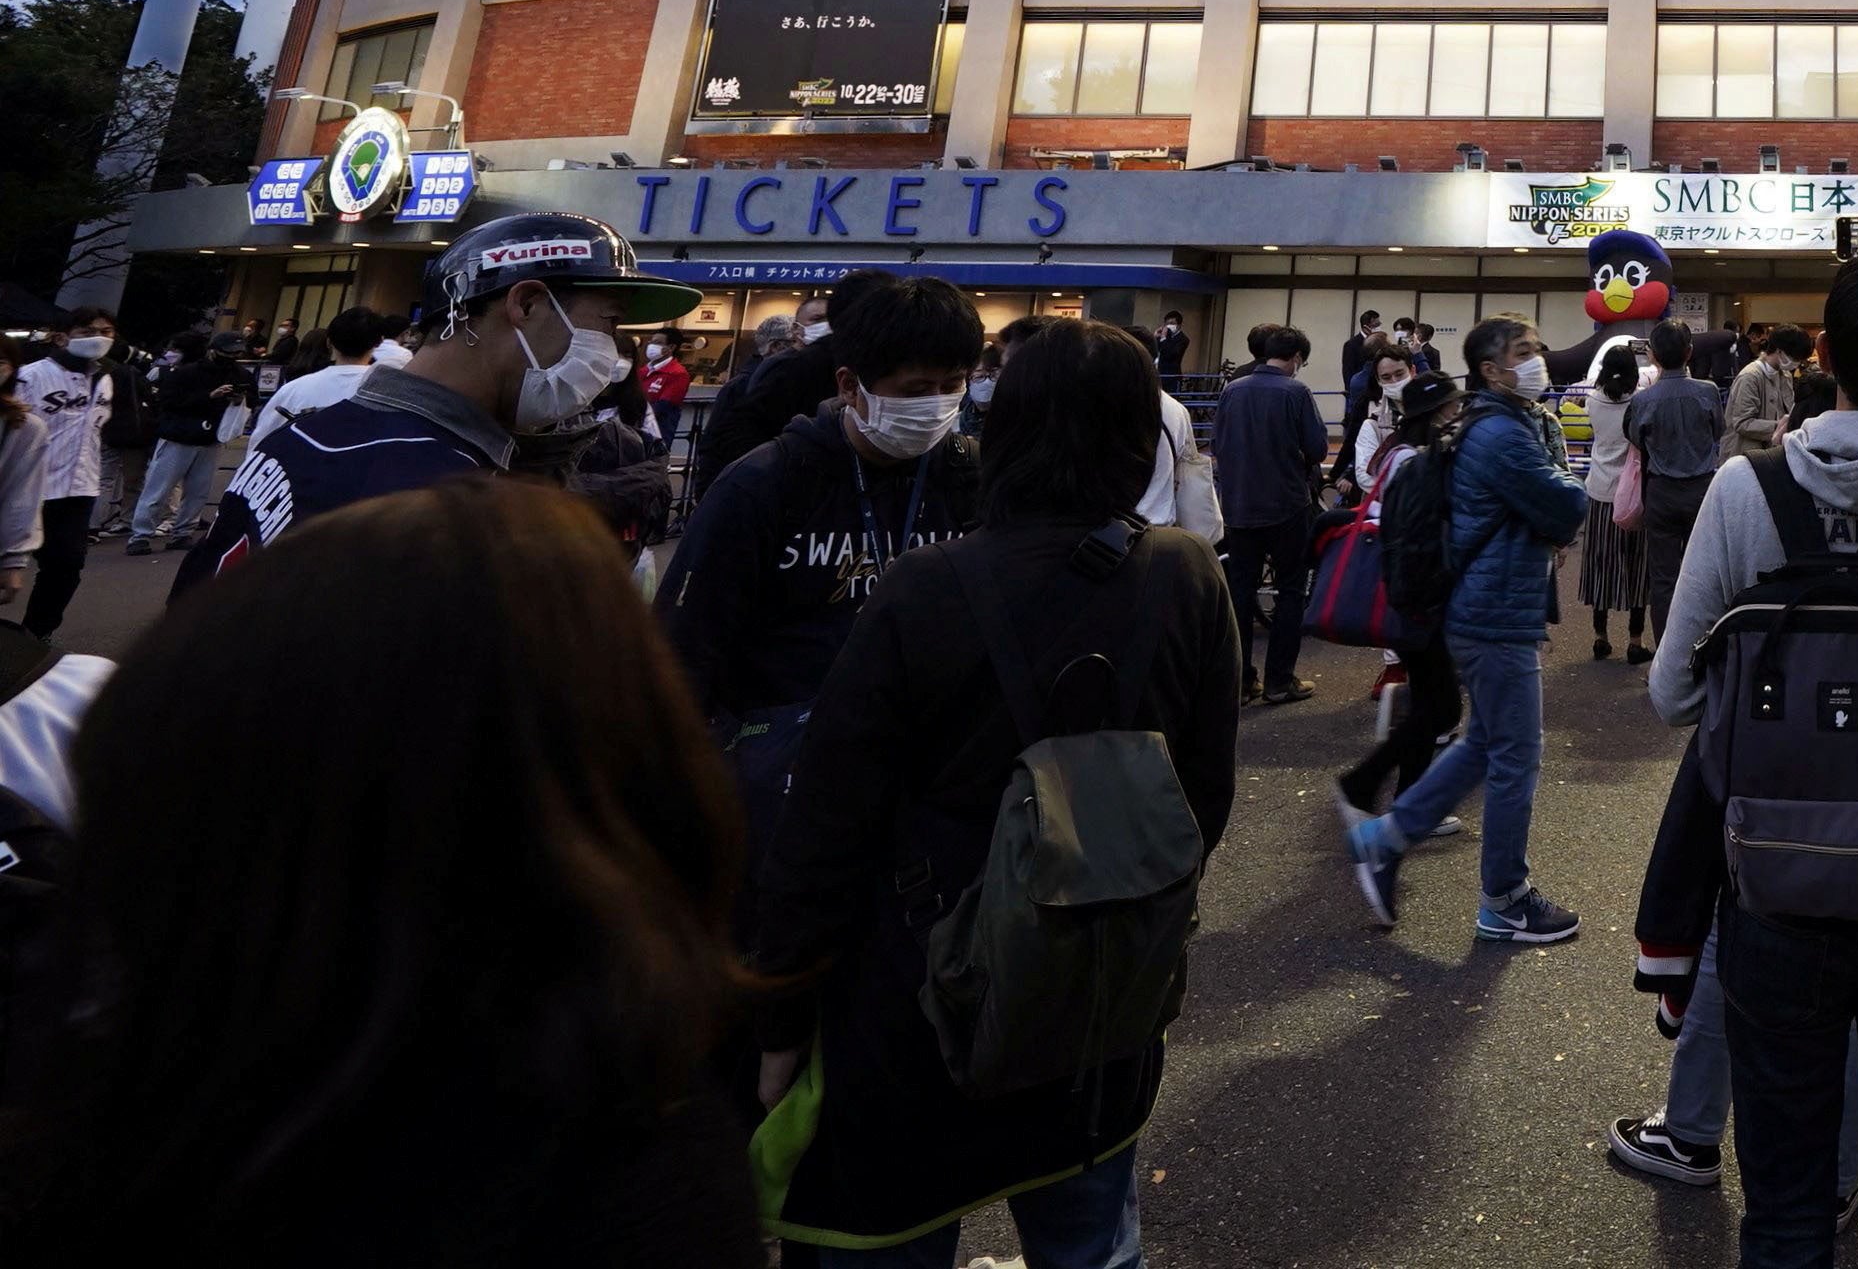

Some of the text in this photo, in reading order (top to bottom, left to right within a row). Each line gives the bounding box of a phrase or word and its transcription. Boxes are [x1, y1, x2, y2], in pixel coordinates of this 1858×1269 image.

[781, 16, 876, 29] さあ、行こうか。
[1539, 191, 1584, 206] SMBC
[1653, 178, 1777, 214] SMBC
[637, 176, 1069, 237] TICKETS
[1510, 206, 1630, 222] NIPPON SERIES
[1654, 224, 1826, 242] 東京ヤクルトスワローズ
[487, 244, 588, 263] Yurina
[708, 266, 858, 279] 7入口横 チケットボック
[779, 531, 964, 570] SWALL
